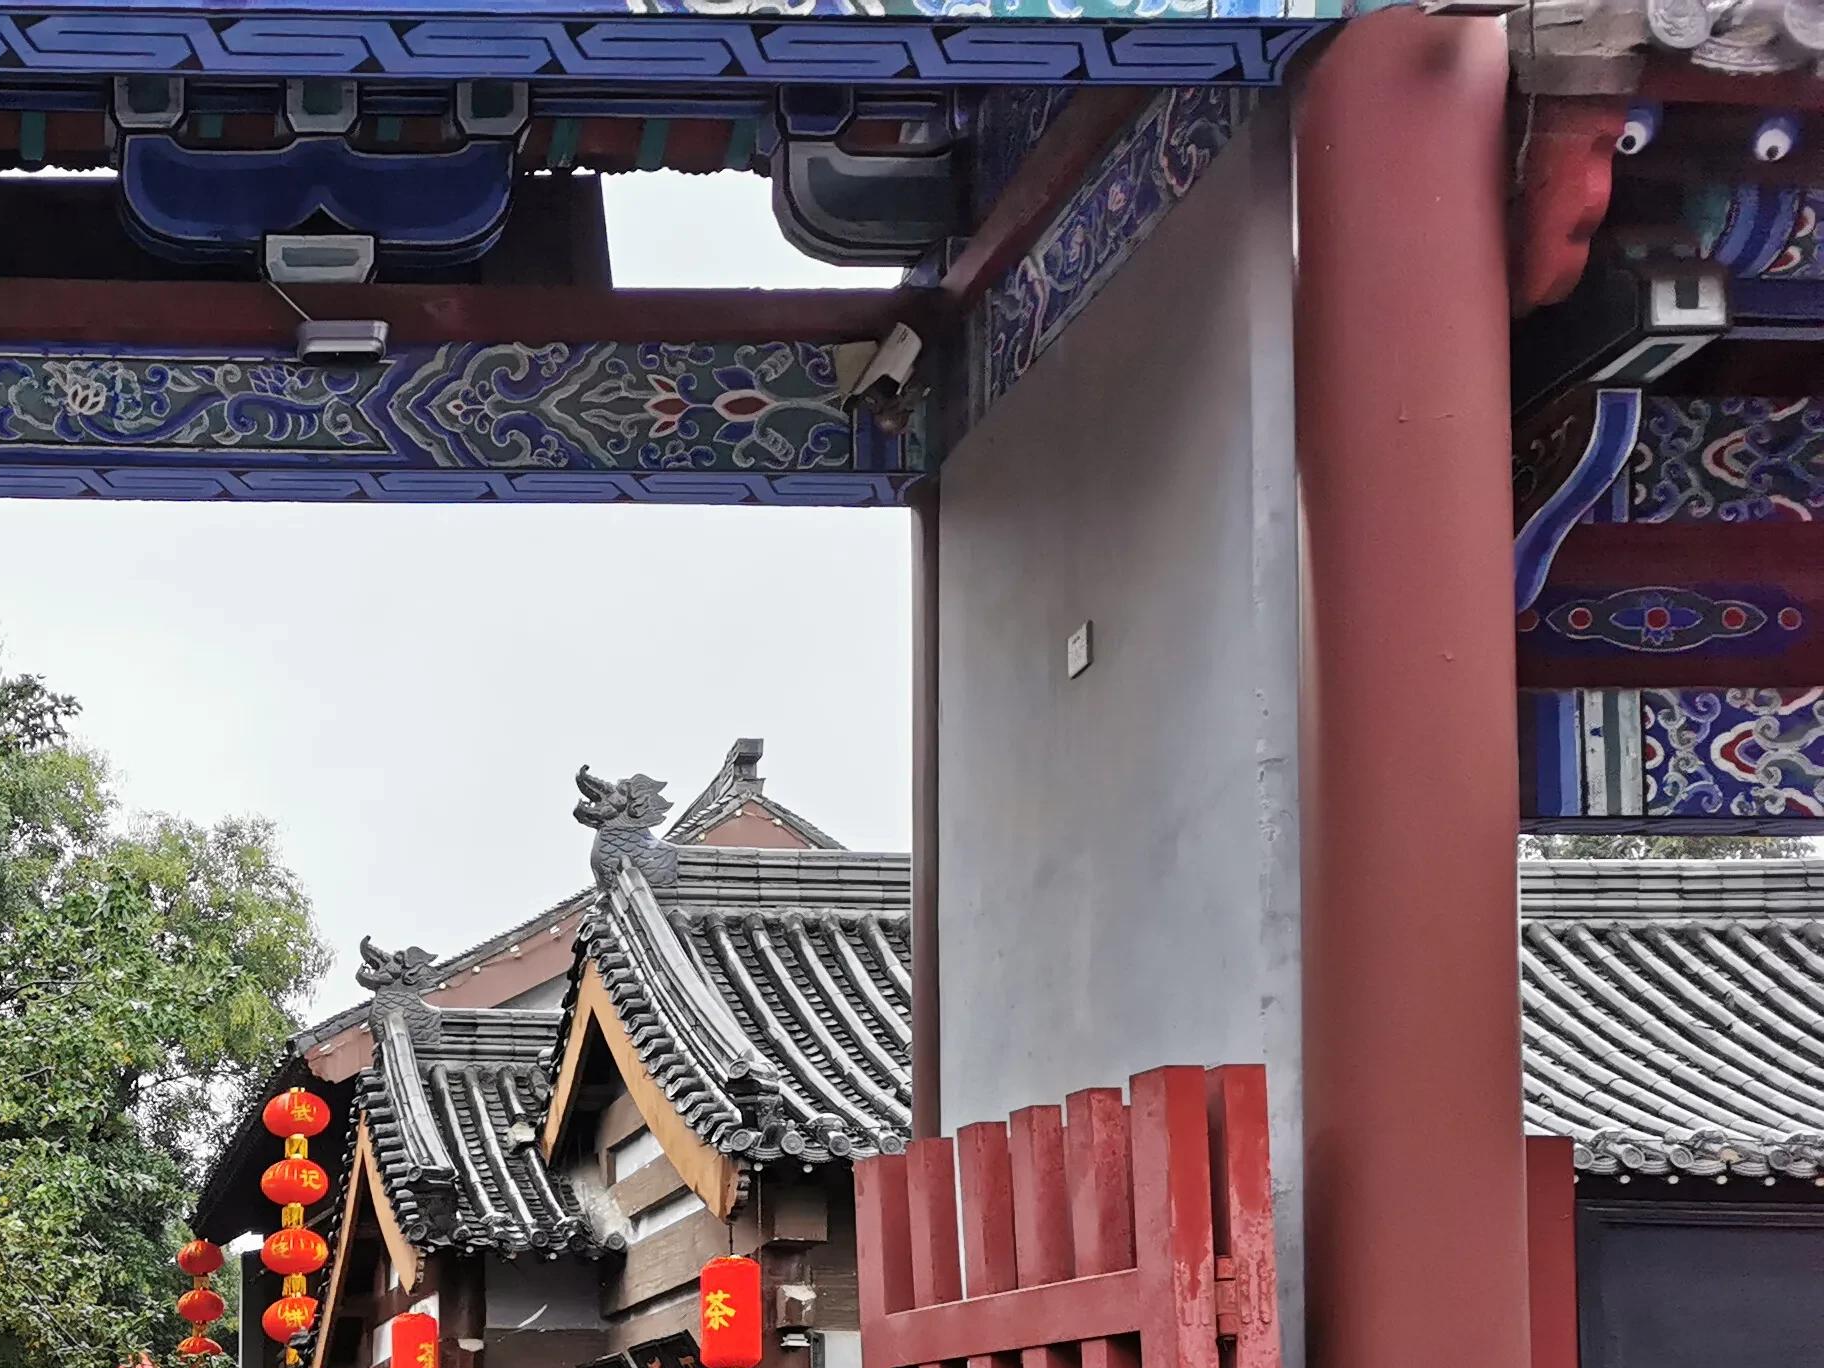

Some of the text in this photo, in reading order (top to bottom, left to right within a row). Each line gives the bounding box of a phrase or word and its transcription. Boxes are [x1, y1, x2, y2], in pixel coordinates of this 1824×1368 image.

[291, 1105, 314, 1122] 武
[300, 1169, 322, 1190] 记
[704, 1289, 736, 1330] 茶
